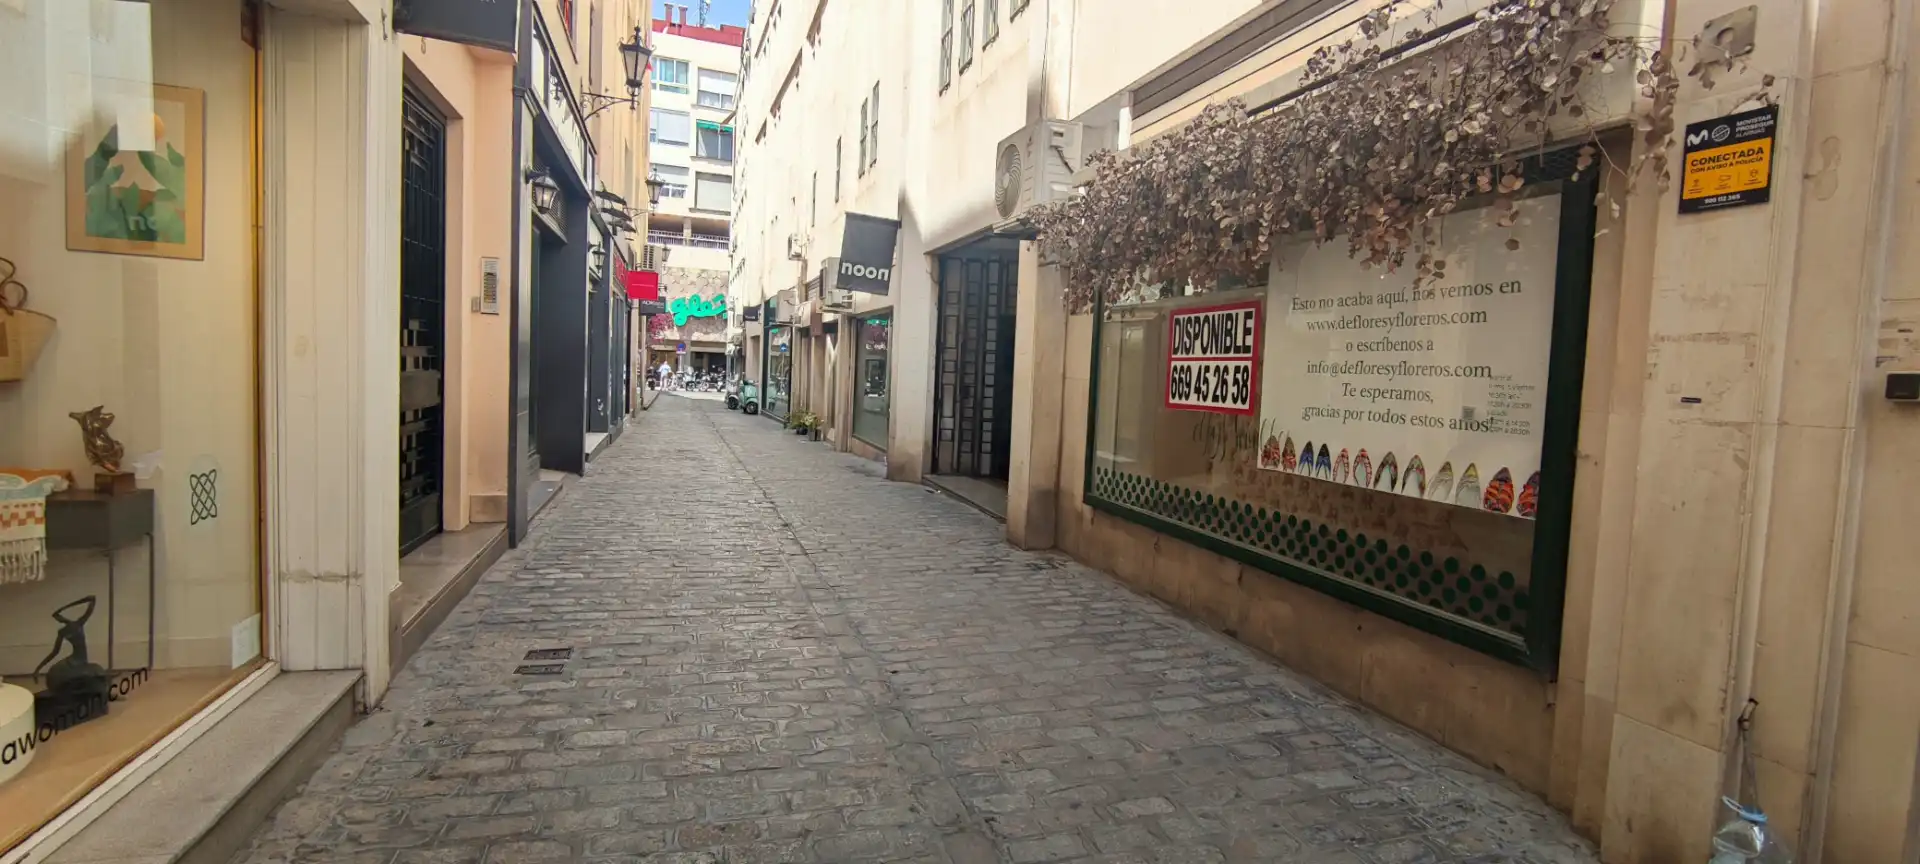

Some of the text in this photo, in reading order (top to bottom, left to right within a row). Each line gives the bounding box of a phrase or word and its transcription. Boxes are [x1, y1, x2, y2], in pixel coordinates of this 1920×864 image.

[1735, 120, 1774, 133] PROSEGUR
[1736, 114, 1772, 127] MOVISTAR
[1691, 146, 1764, 167] CONECTADA
[1690, 166, 1707, 174] CON
[1706, 161, 1728, 172] AVISO
[841, 262, 890, 282] noon
[1291, 280, 1522, 311] Esto no acaba aquí, nos vemos en
[1306, 310, 1488, 334] www.defloresyfloreros.com
[1172, 310, 1254, 356] DISPONIBLE
[1345, 336, 1434, 352] o escríbenos a
[1307, 360, 1492, 382] info@defloresyfloreros.com
[1170, 364, 1250, 405] 669 45 26 58
[1341, 382, 1434, 404] Te esperamos,
[1342, 408, 1364, 424] por
[1367, 408, 1407, 425] todos
[1410, 413, 1445, 429] estos
